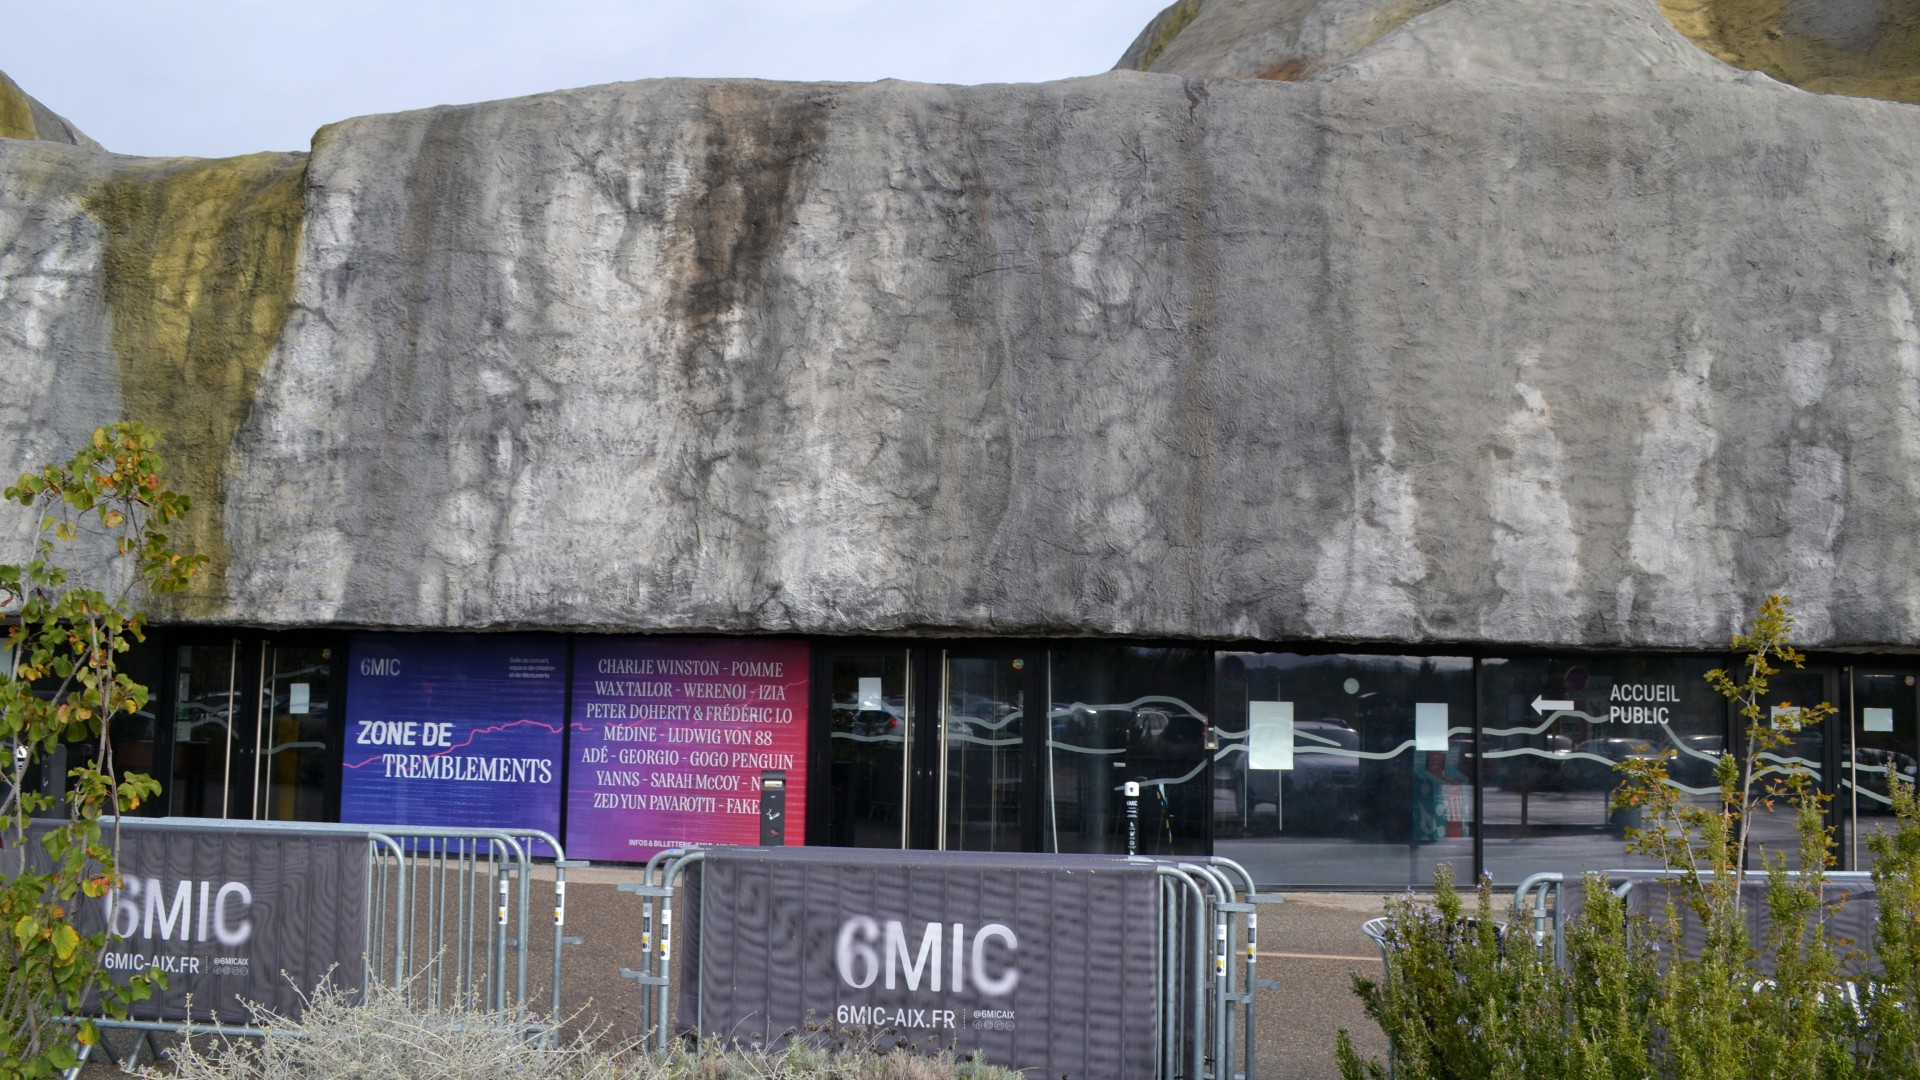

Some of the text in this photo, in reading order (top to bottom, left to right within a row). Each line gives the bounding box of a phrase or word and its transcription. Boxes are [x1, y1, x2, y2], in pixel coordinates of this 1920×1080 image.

[361, 658, 400, 676] 6MIC
[598, 659, 654, 675] CHARLIE
[657, 660, 719, 675] WINSTON
[731, 662, 783, 678] POMME
[595, 681, 624, 696] WAX
[626, 682, 672, 697] TAILOR
[684, 684, 746, 699] WERENOI
[759, 685, 785, 700] IZIA
[1610, 684, 1680, 702] ACCUEIL
[586, 703, 792, 723] PETER DOHERTY & FRÉDÉRIC LO
[1610, 706, 1669, 724] PUBLIC
[357, 721, 452, 746] ZONE DE
[604, 724, 657, 742] MÉDINE
[668, 729, 721, 744] LUDWIG
[724, 730, 751, 745] VON
[755, 731, 772, 746] 88
[382, 753, 552, 783] TREMBLEMENTS
[582, 746, 608, 763] ADÉ
[619, 749, 679, 765] GEORGIO
[690, 751, 728, 767] GOGO
[732, 753, 793, 769] PENGUIN
[596, 771, 639, 787] YANNS
[651, 773, 692, 789] SARAH
[695, 774, 740, 790] McCOY
[594, 793, 618, 809] ZED
[621, 794, 647, 809] YUN
[650, 796, 715, 812] PAVAROTTI
[726, 799, 762, 814] FAKE
[105, 874, 252, 946] 6MIC
[105, 952, 248, 973] 6MIC-AIX.FR @6MICAIX
[836, 914, 1019, 996] 6MIC
[837, 1004, 1015, 1029] 6MIC-AIX.FR @6MICAIX
